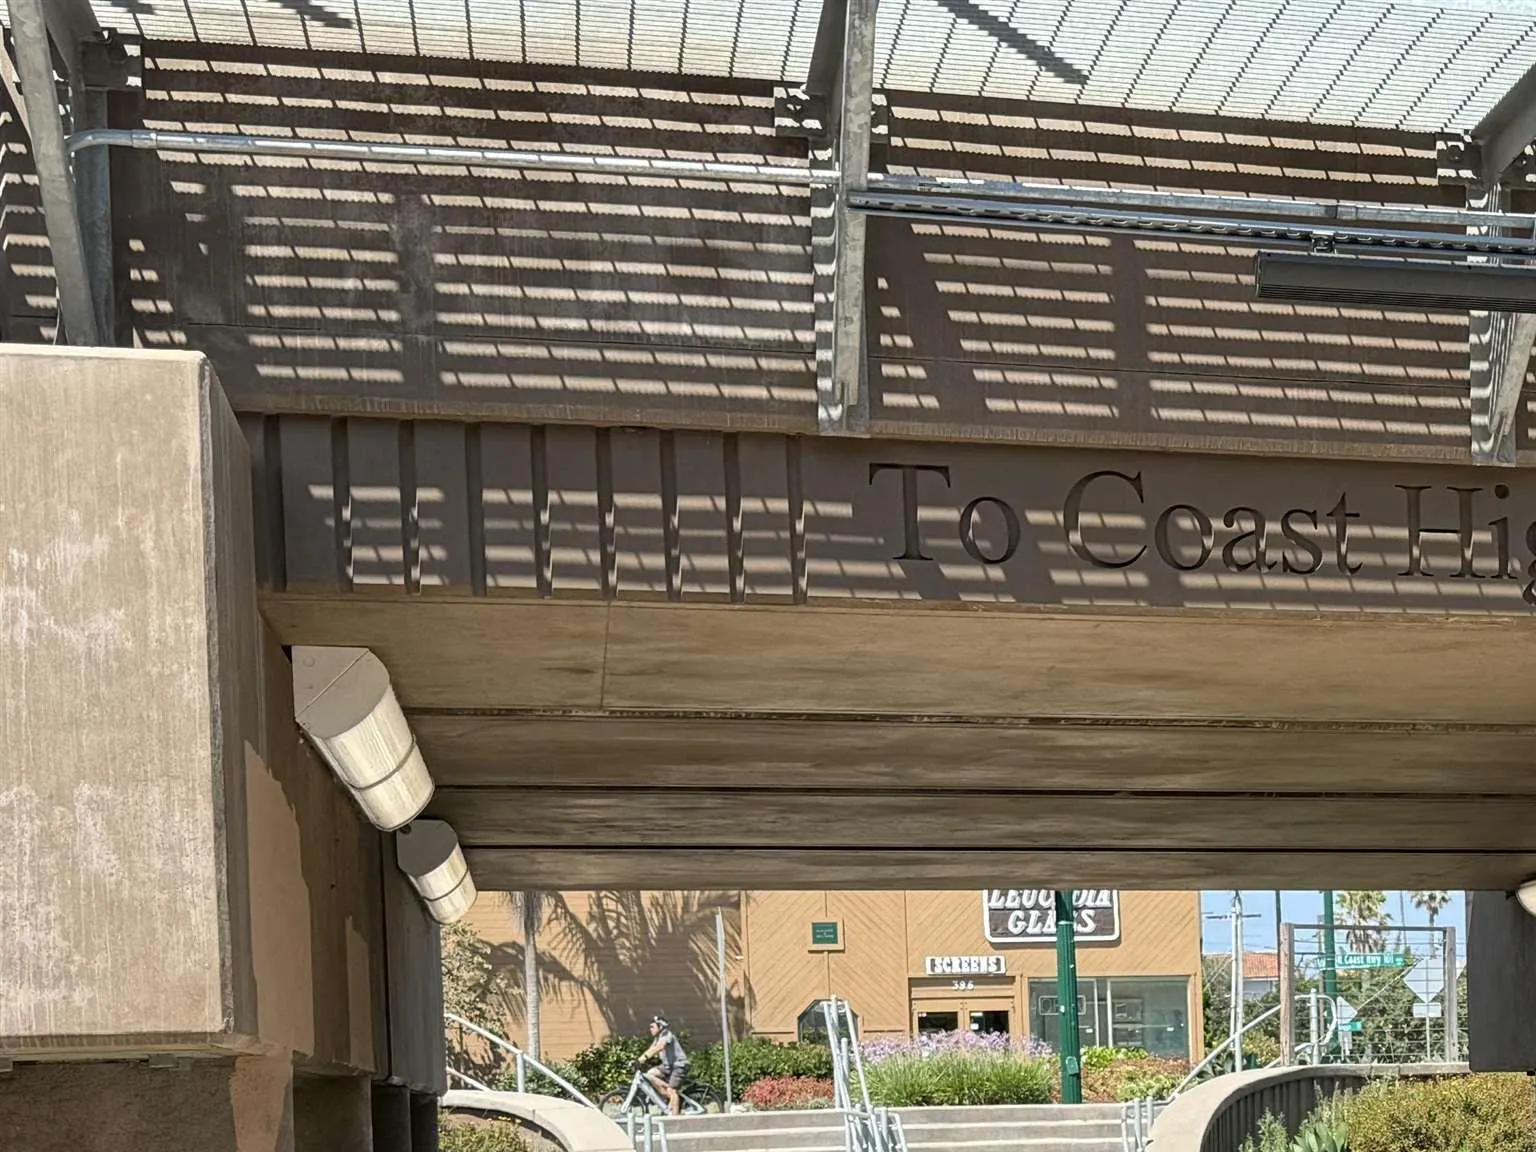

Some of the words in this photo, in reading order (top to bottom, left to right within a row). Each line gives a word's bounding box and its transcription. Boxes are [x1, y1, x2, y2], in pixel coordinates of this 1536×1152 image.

[869, 462, 1021, 564] To
[1063, 470, 1363, 576] Coast
[988, 890, 1112, 909] LEUCDIA
[934, 957, 998, 974] SCREENS
